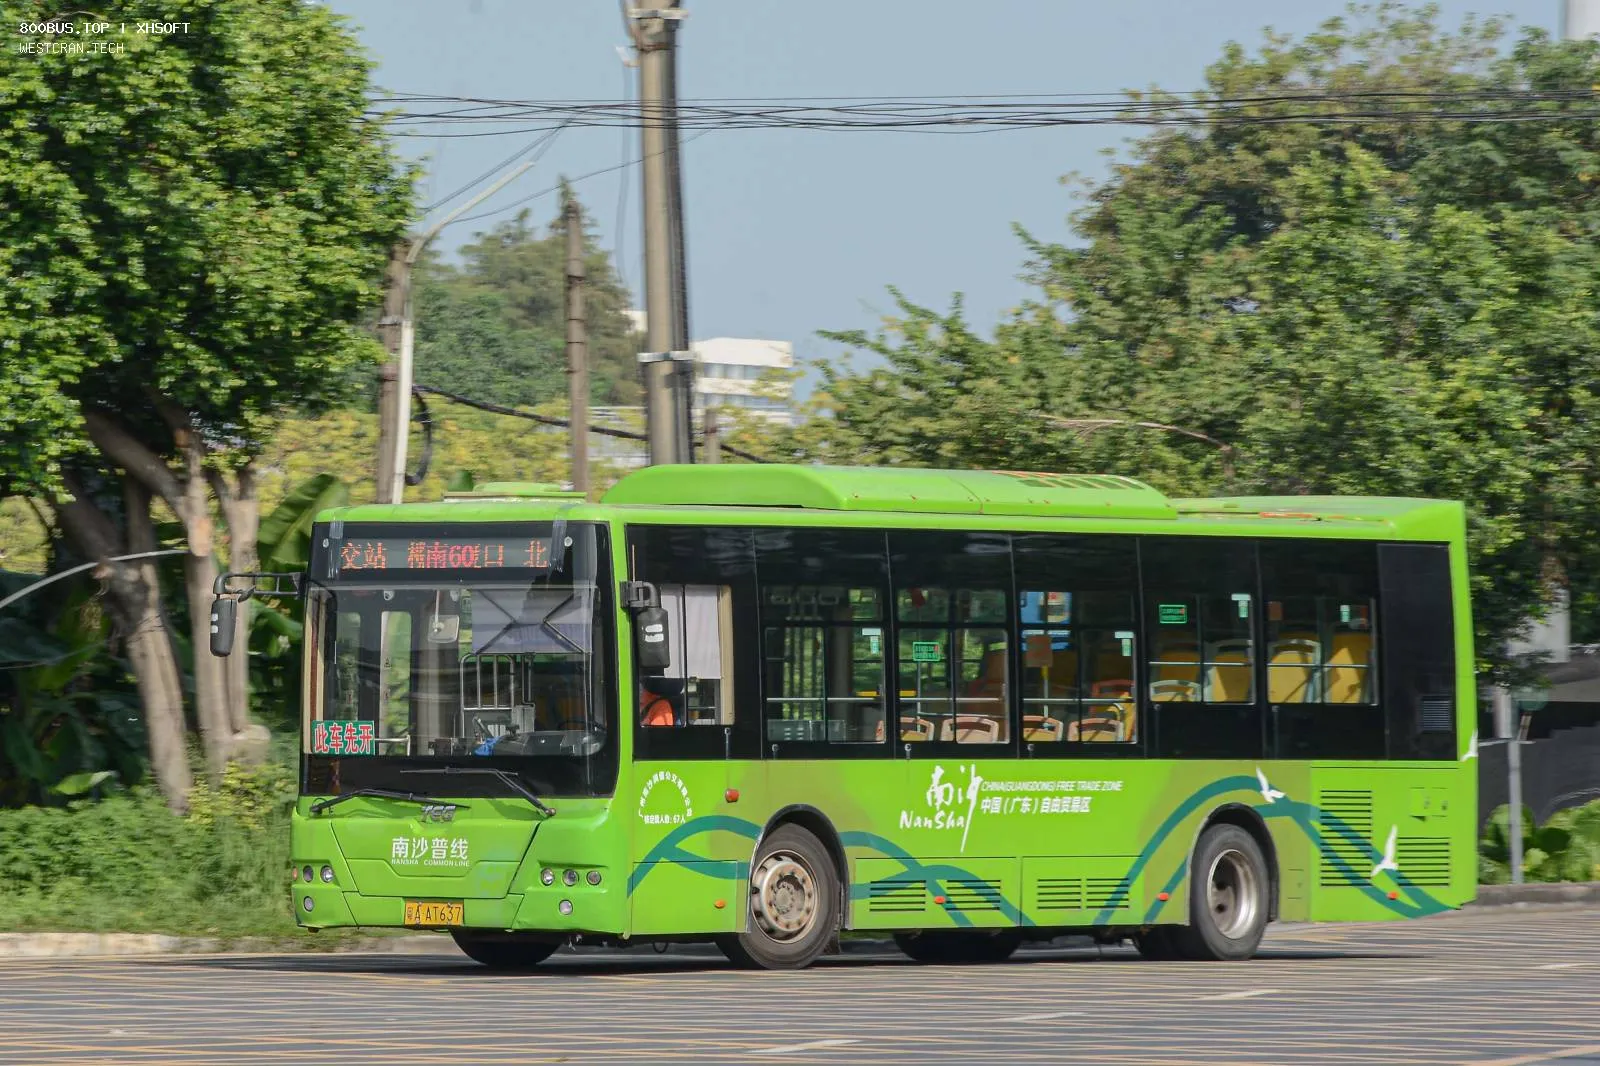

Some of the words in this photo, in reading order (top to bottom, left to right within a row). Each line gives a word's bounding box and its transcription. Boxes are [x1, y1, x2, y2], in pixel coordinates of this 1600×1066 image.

[341, 542, 387, 569] 交站
[523, 540, 548, 568] 北
[314, 722, 373, 755] 此车先开
[1055, 781, 1077, 792] FREE
[1077, 780, 1101, 791] TRADE
[926, 763, 983, 853] 南沙
[391, 836, 469, 860] 南沙普线
